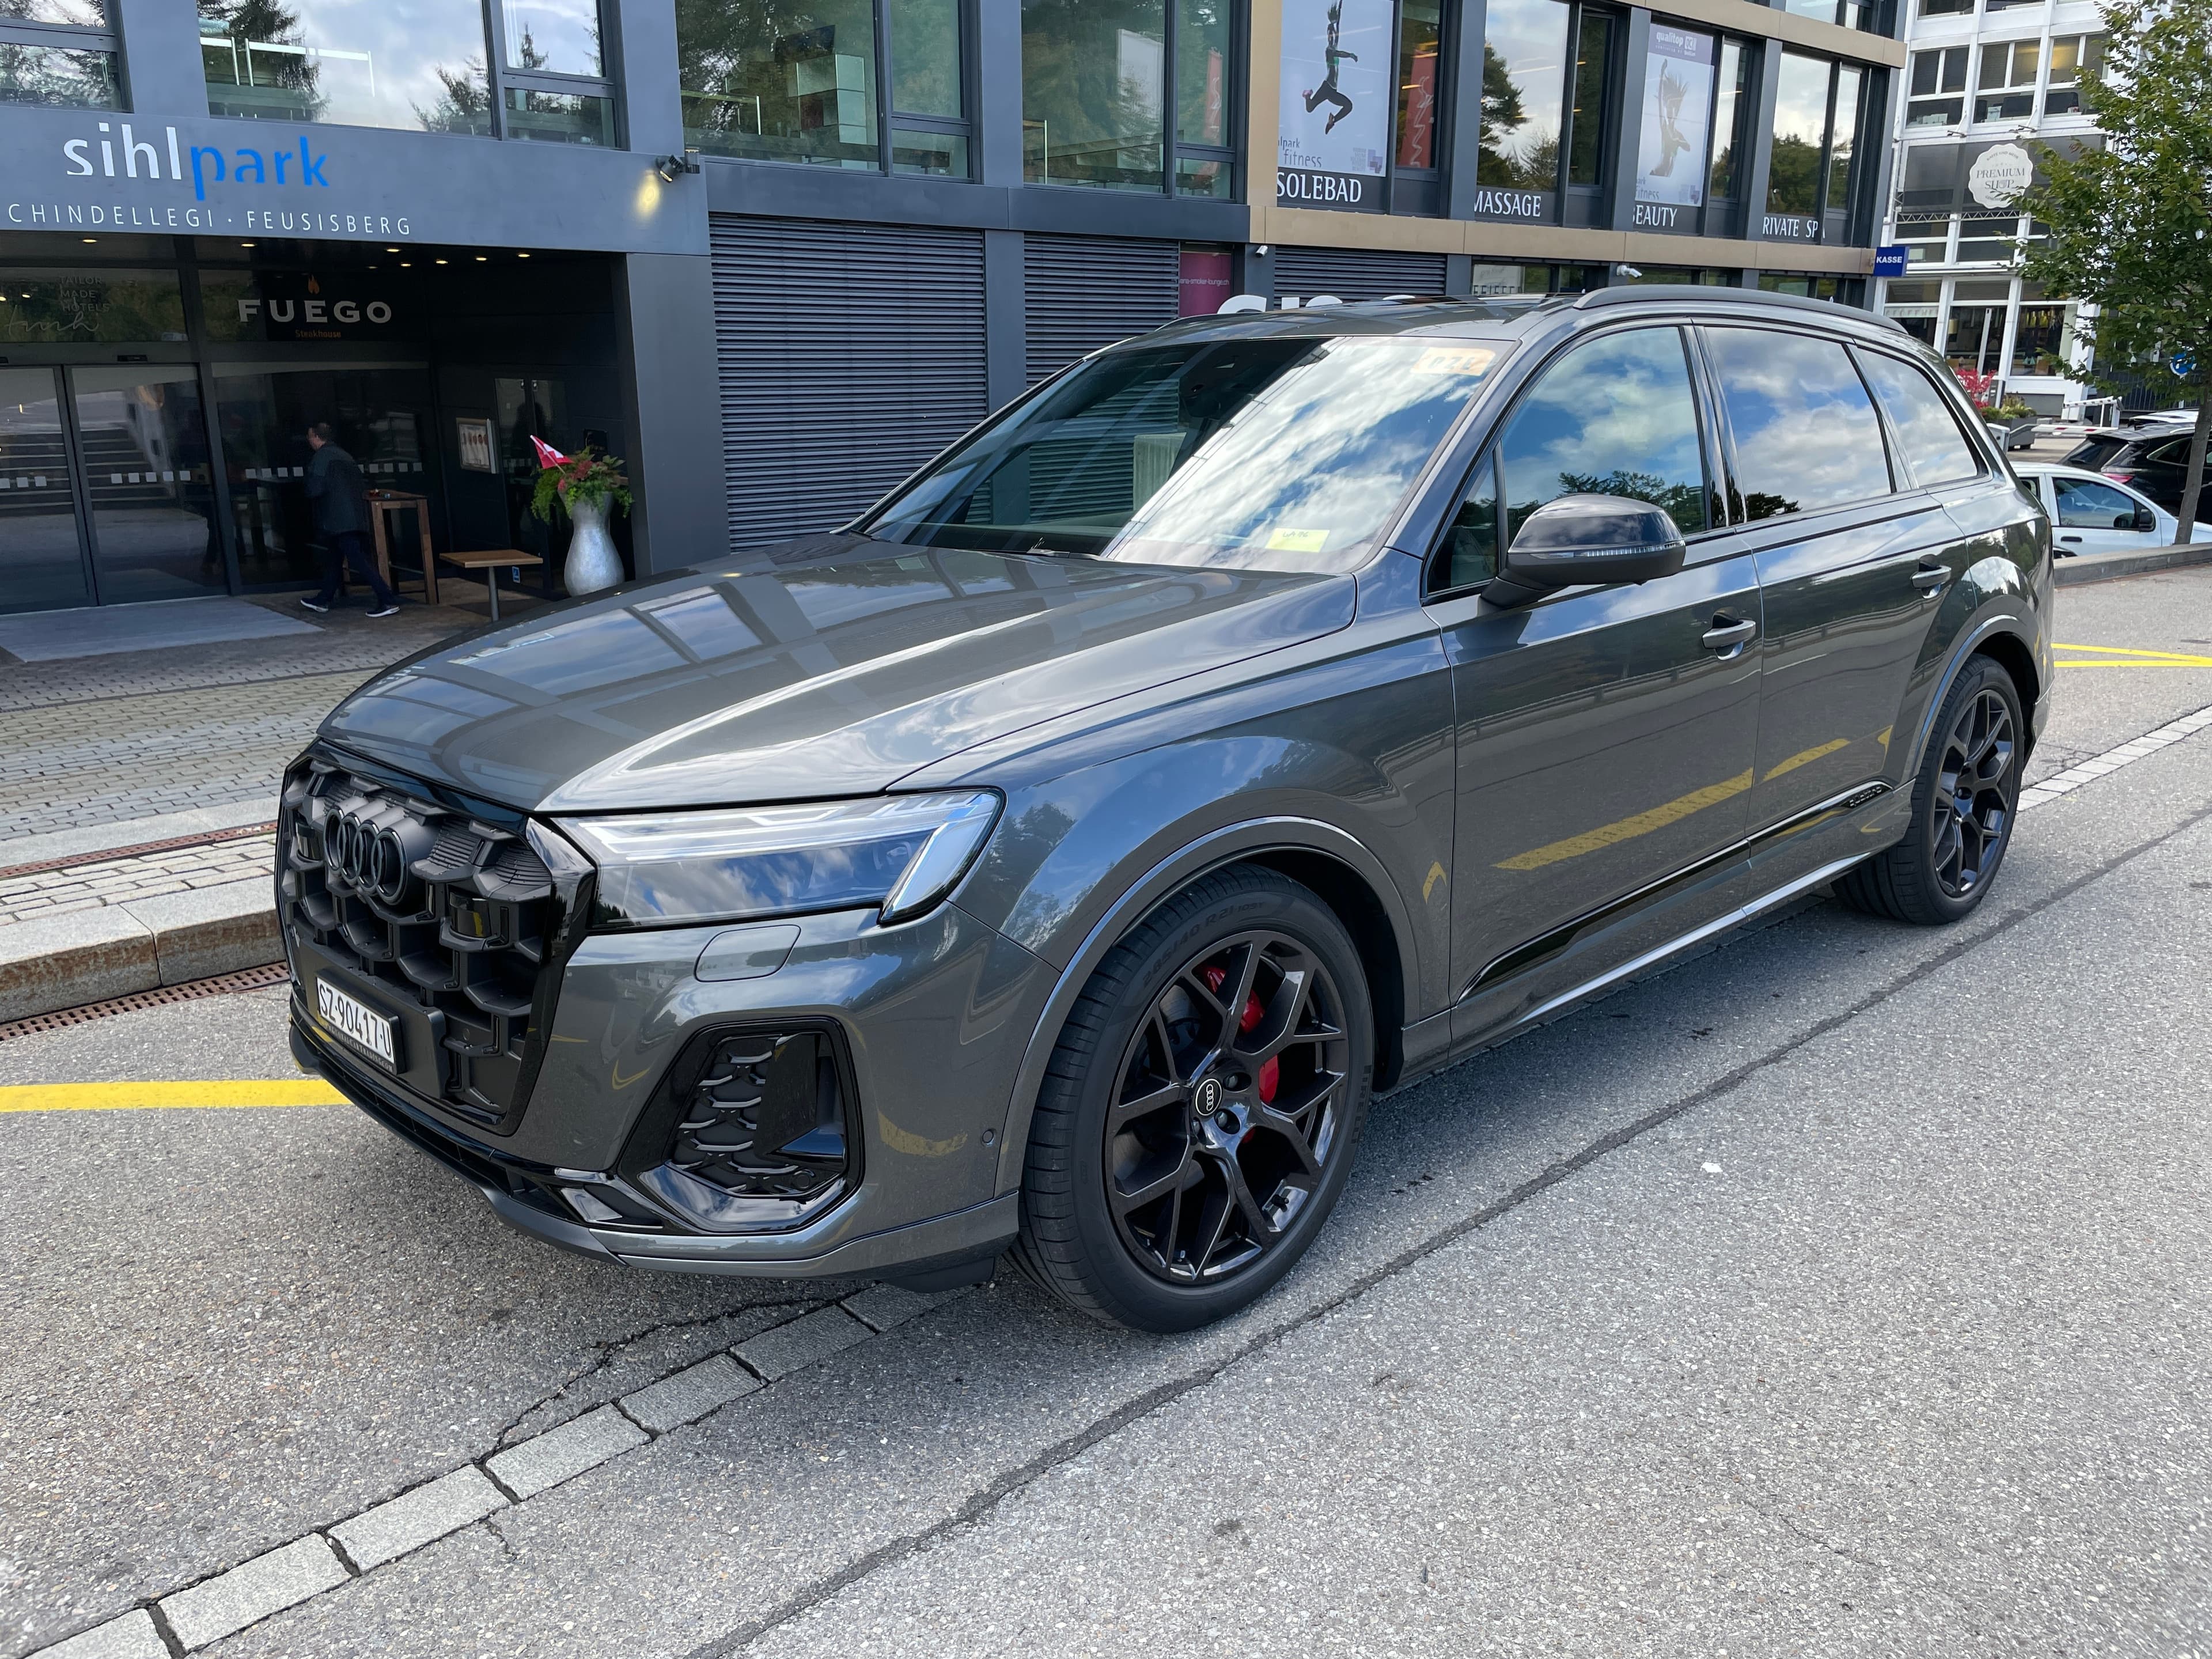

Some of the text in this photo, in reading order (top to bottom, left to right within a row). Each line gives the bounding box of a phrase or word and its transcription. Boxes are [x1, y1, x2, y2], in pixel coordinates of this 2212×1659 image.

[1656, 32, 1683, 47] qualitop
[63, 122, 329, 201] sihlpark
[1284, 149, 1322, 168] fitness
[1976, 168, 2025, 179] PREMIUM
[1277, 172, 1362, 202] SOLEBAD
[1984, 180, 2014, 190] SHOP
[8, 203, 410, 235] CHINDELLEGI FEUSISBERG
[1633, 204, 1677, 227] EAUTY
[1763, 217, 1798, 237] RIVATE
[60, 276, 102, 285] TAILOR
[60, 290, 97, 298] MADE
[62, 304, 110, 312] HOTELS
[237, 300, 392, 323] FUEGO
[295, 329, 342, 338] Steakhouse
